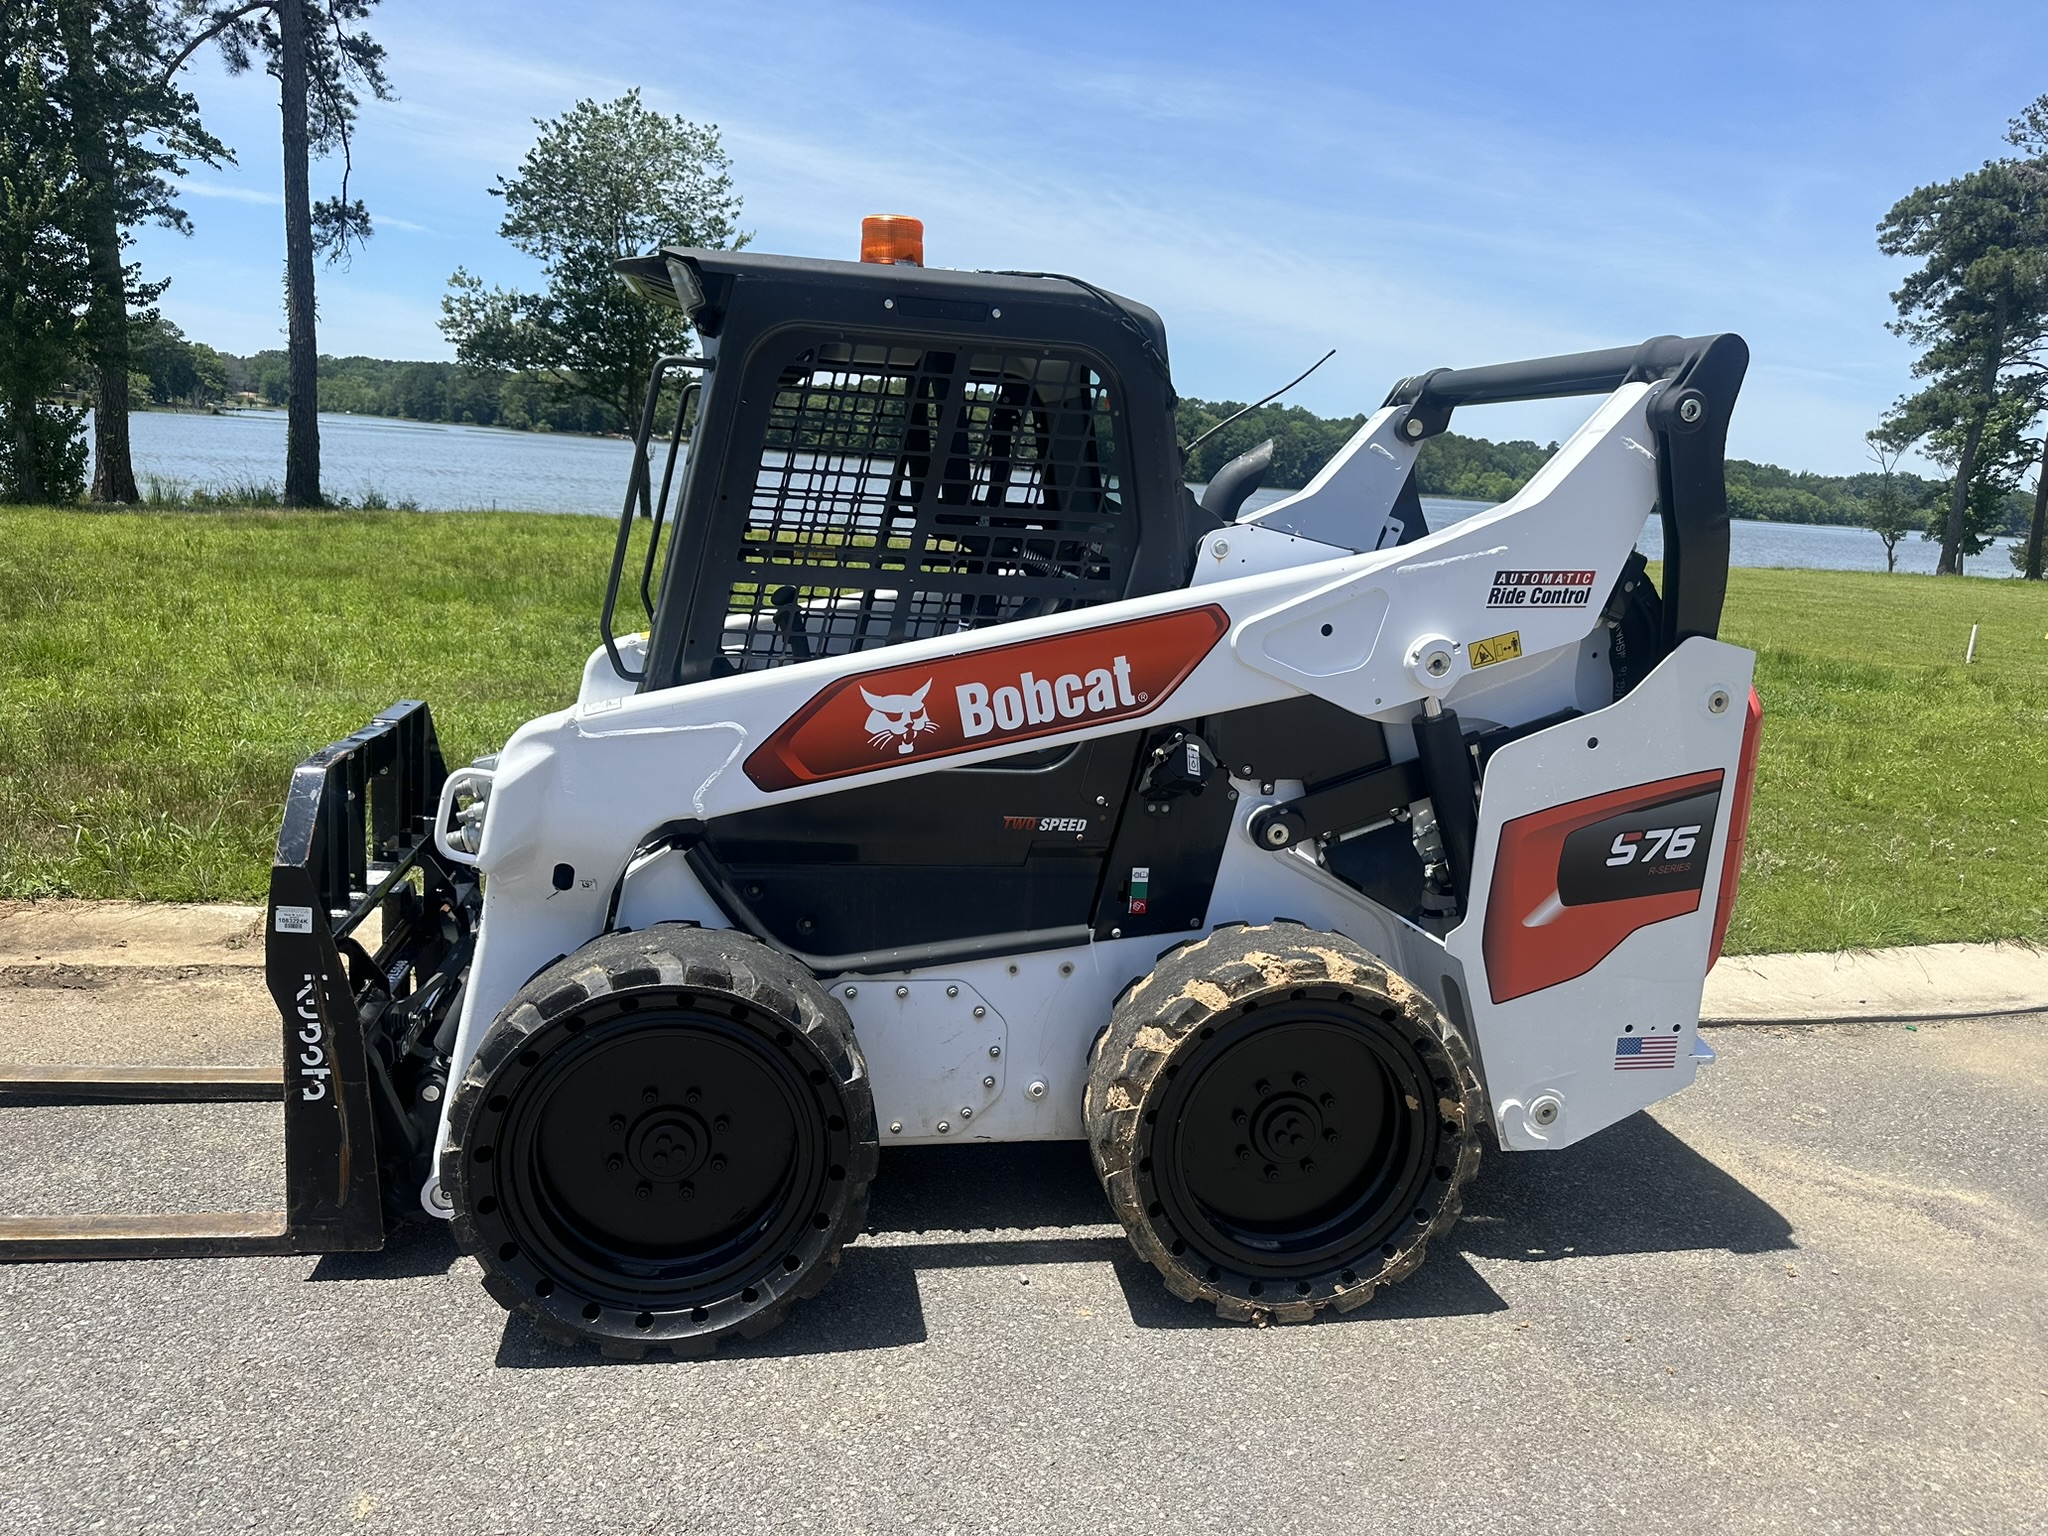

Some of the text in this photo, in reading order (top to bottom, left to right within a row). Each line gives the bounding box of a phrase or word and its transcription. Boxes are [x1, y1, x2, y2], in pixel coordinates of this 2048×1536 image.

[1497, 572, 1591, 584] AUTOMATIC
[1487, 587, 1592, 604] Ride Control
[955, 655, 1136, 739] Bobcat
[1003, 816, 1088, 832] TWO SPEED
[1605, 824, 1701, 867] S76
[1648, 862, 1691, 875] R-SERIES
